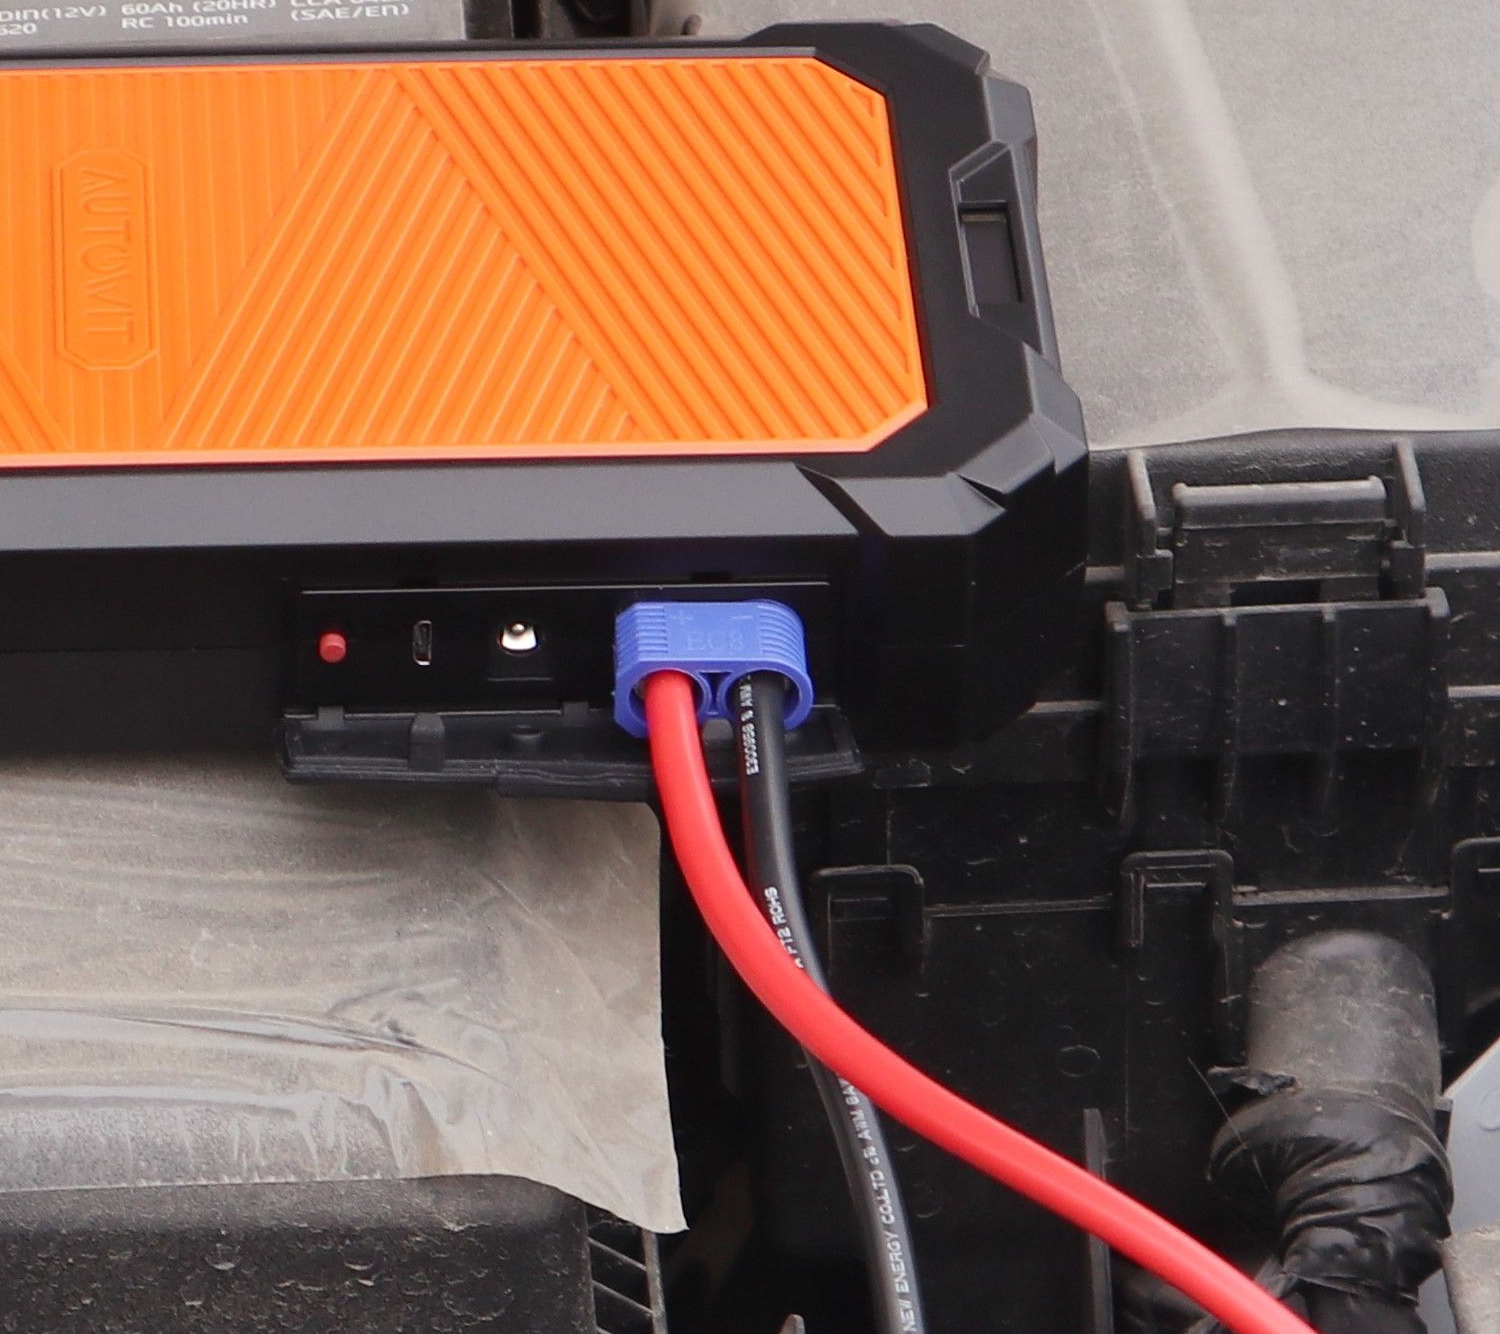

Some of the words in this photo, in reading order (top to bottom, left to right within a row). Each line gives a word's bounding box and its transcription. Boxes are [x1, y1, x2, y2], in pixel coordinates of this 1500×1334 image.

[121, 1, 183, 16] 60Ah
[121, 16, 154, 30] RC
[165, 13, 249, 29] 100min
[764, 886, 788, 926] ROHS
[884, 1230, 910, 1295] ENERGY
[898, 1299, 917, 1333] NEW
